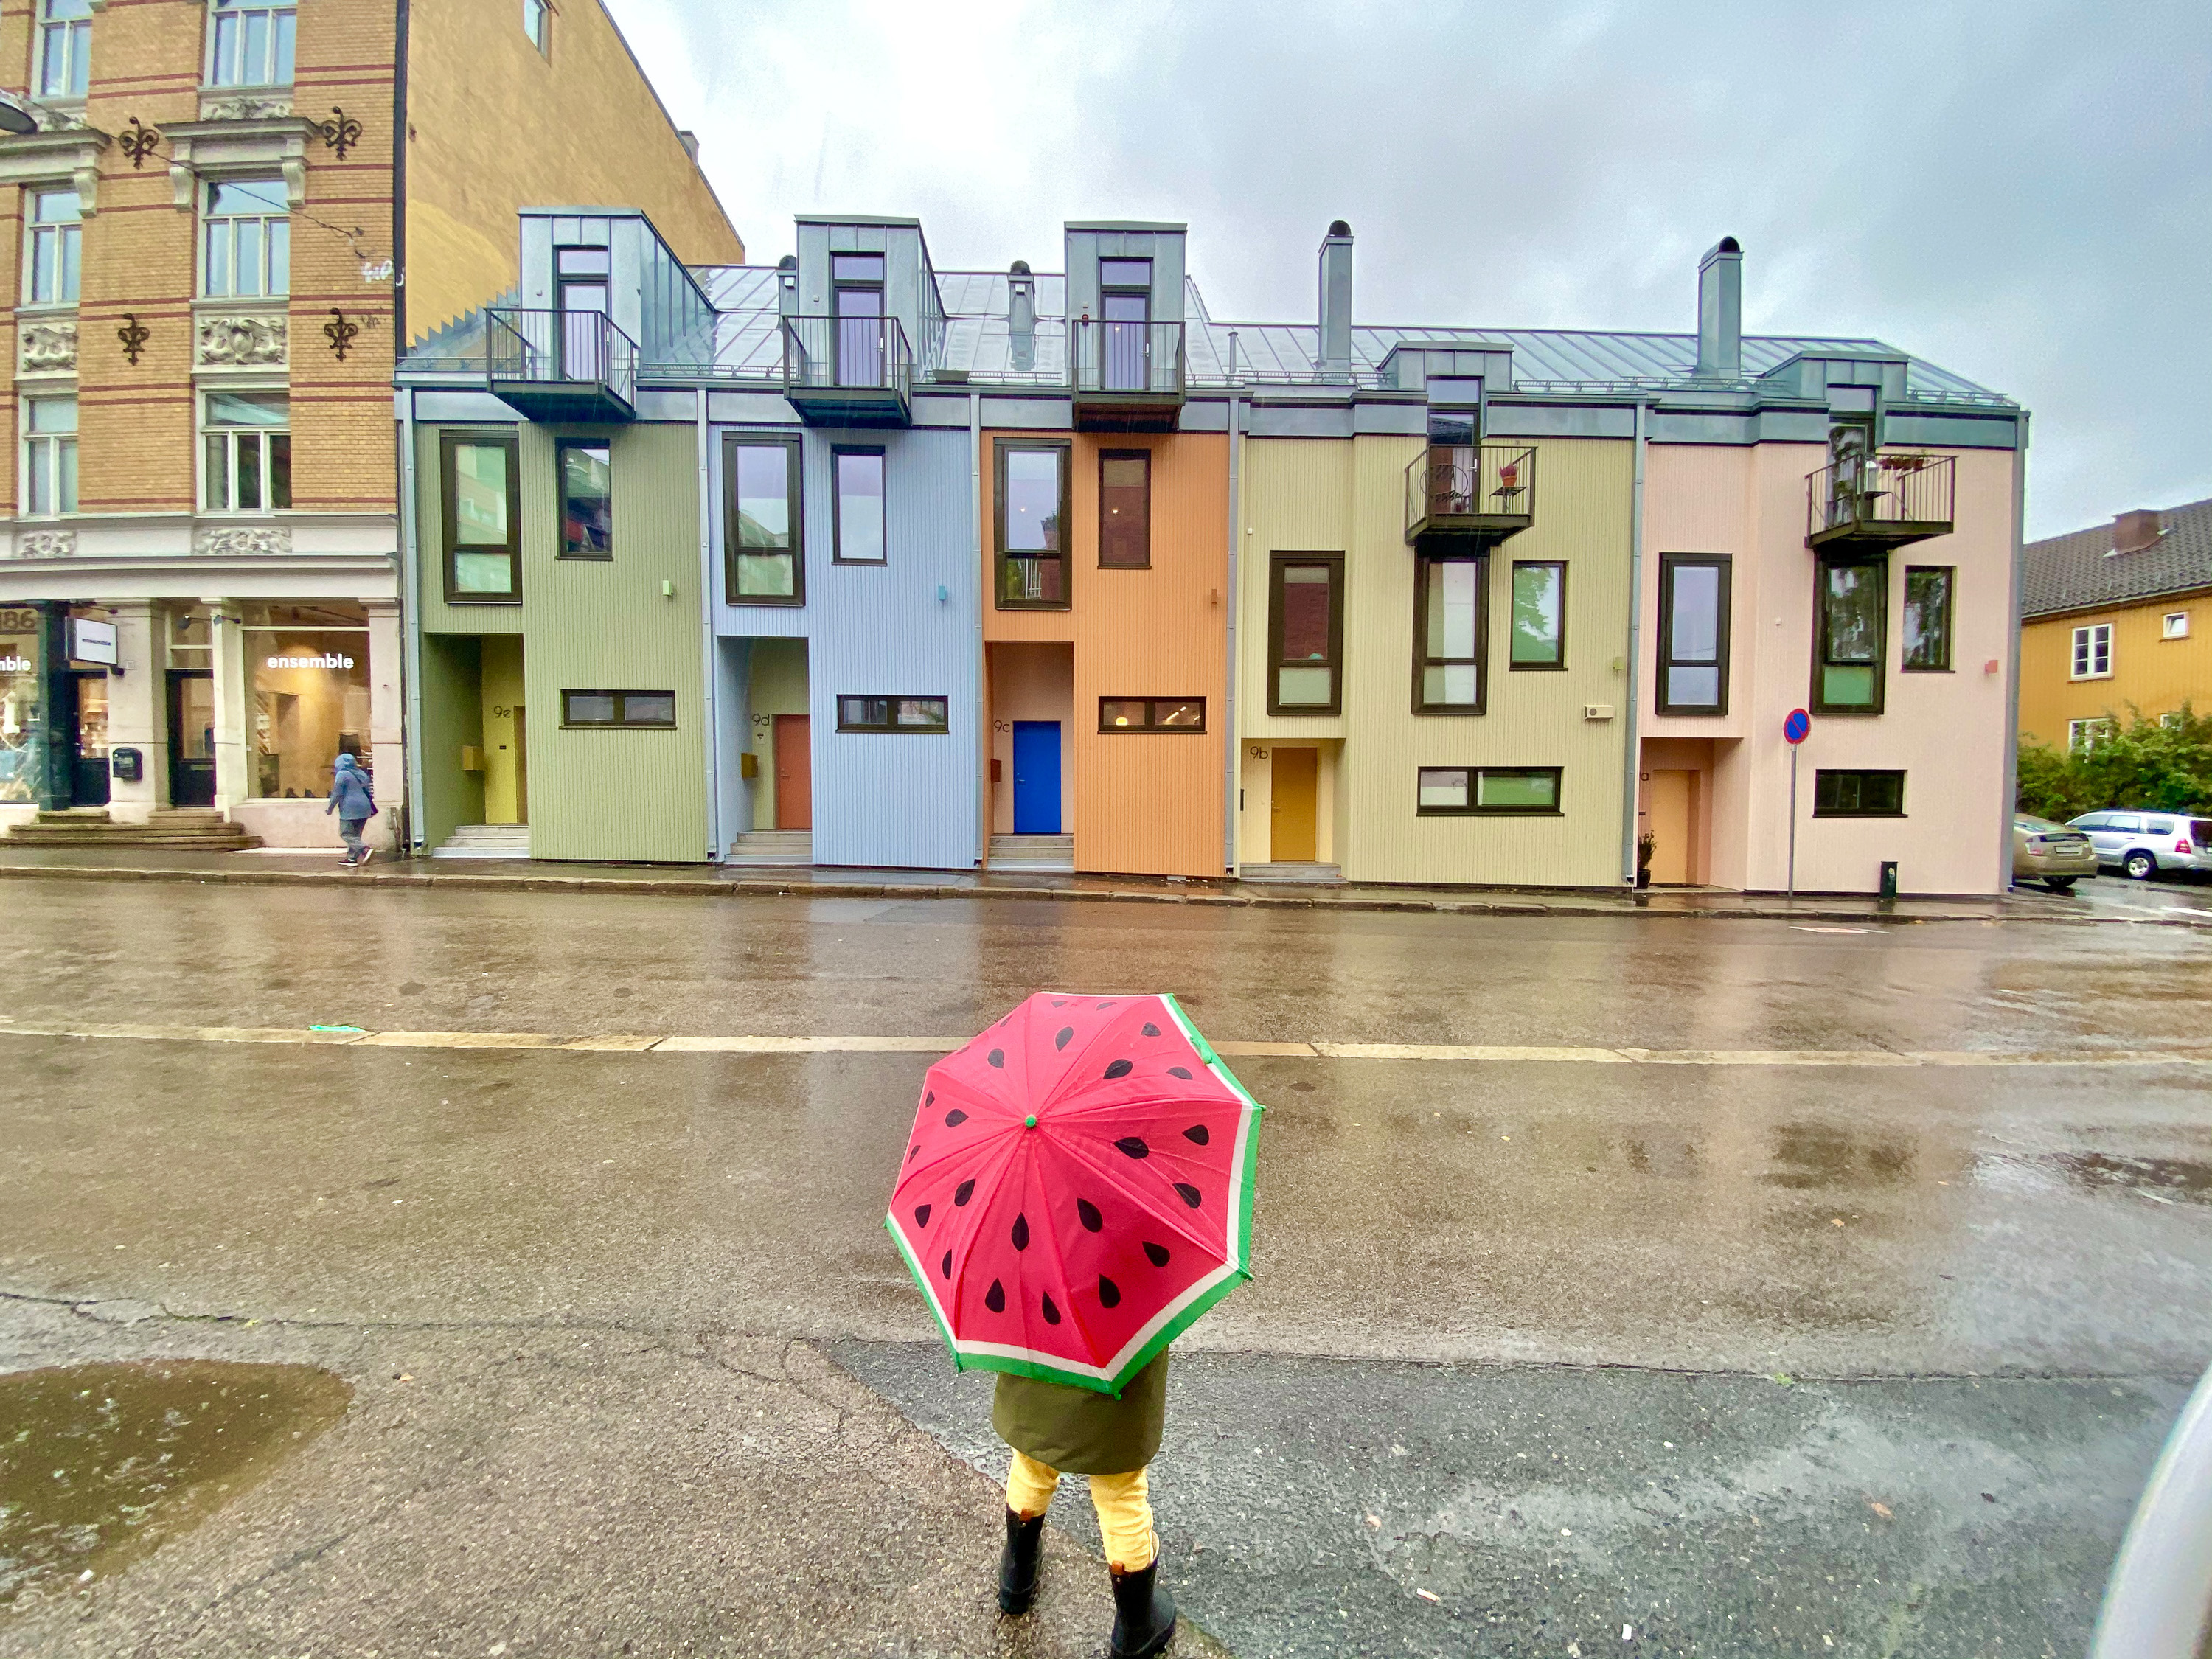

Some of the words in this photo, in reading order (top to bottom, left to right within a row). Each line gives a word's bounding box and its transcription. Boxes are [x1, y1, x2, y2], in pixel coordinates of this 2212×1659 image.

[0, 611, 35, 629] 86
[267, 653, 354, 669] ensemble
[493, 706, 511, 718] 9e
[751, 713, 770, 726] 9d
[993, 720, 1010, 733] 9c
[1250, 746, 1268, 759] 9b
[1641, 772, 1649, 782] a
